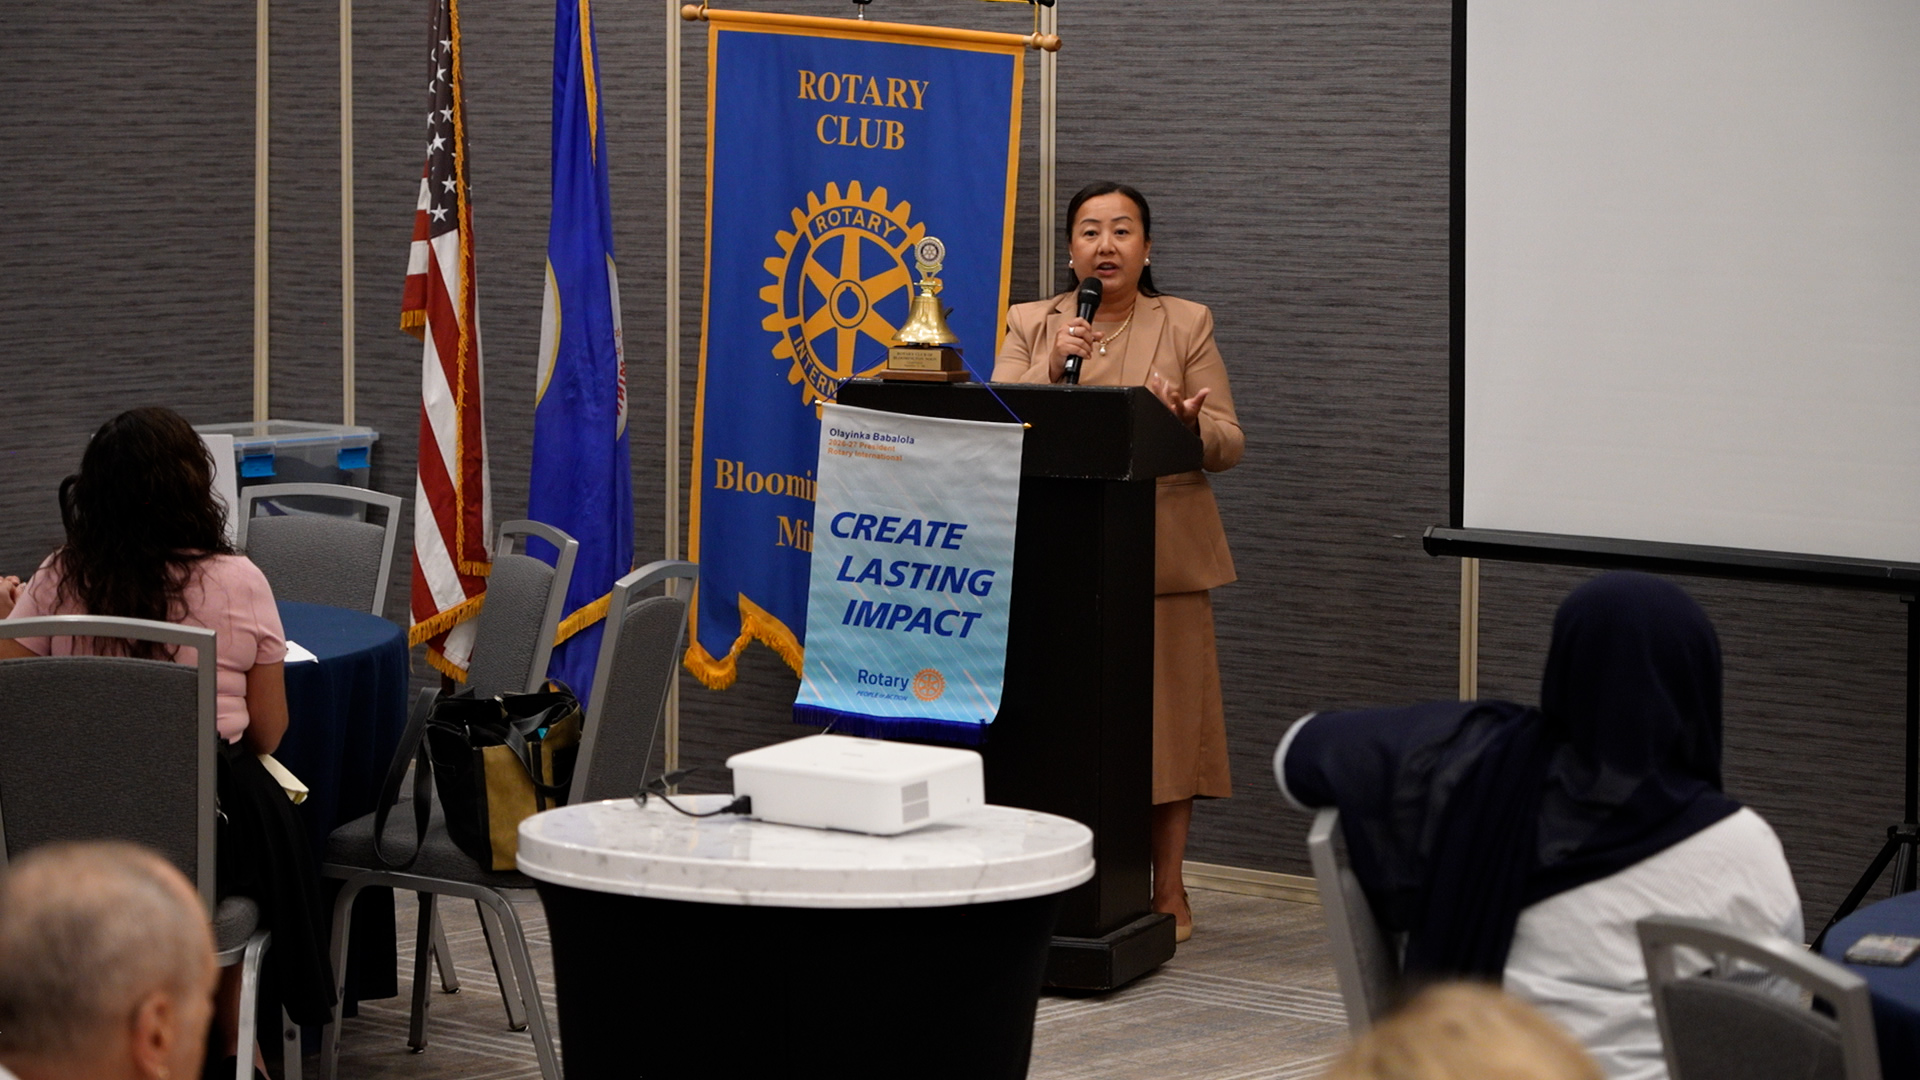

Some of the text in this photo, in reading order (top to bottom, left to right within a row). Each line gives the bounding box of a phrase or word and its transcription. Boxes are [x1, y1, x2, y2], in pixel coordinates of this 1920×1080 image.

[797, 69, 930, 111] ROTARY
[816, 113, 906, 150] CLUB
[815, 208, 898, 238] ROTARY
[828, 439, 896, 452] 2026-27 President
[829, 427, 915, 444] Olayinka Babalola
[827, 447, 903, 461] Rotary International
[830, 511, 968, 550] CREATE
[836, 555, 996, 597] LASTING
[841, 599, 983, 638] IMPACT
[856, 690, 879, 698] PEOPLE
[884, 693, 909, 701] ACTION
[857, 669, 910, 692] Rotary
